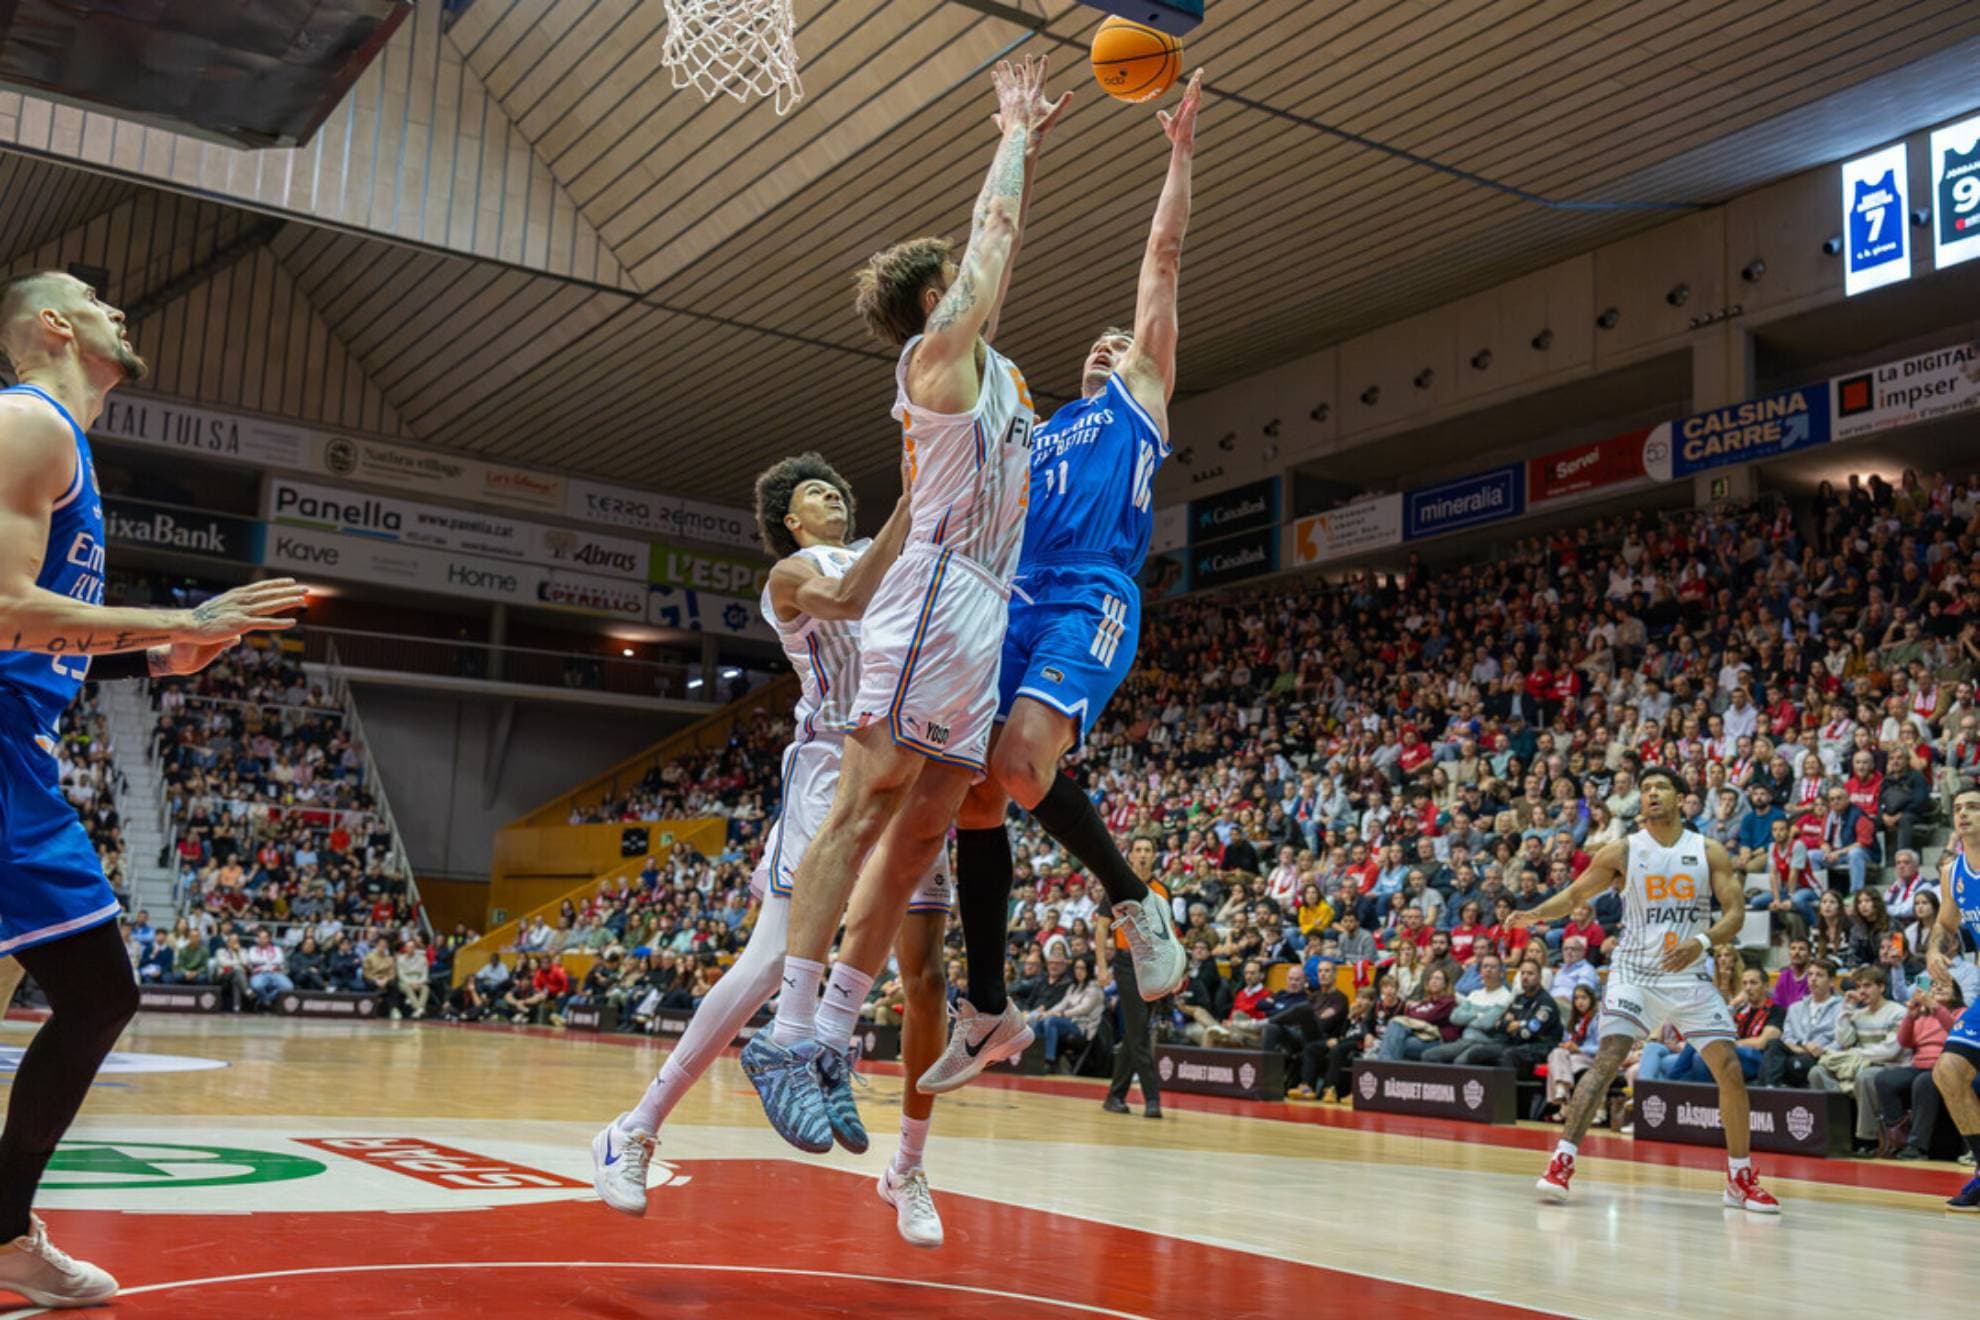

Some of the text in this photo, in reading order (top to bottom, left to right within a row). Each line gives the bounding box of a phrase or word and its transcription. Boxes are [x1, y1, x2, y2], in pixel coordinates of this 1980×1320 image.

[1952, 175, 1980, 213] 9
[1865, 206, 1886, 243] 7
[1903, 345, 1976, 377] DIGITAL
[1878, 375, 1960, 412] impser
[91, 400, 148, 438] EAL
[1682, 391, 1808, 440] CALSINA
[276, 486, 401, 530] Panella
[1420, 484, 1504, 524] mineralia
[276, 536, 340, 566] Kave
[448, 563, 518, 593] Home
[573, 543, 636, 573] Abras
[1644, 873, 1697, 901] BG
[1645, 906, 1700, 924] FIATC
[1676, 1101, 1722, 1129] BÀSQUE
